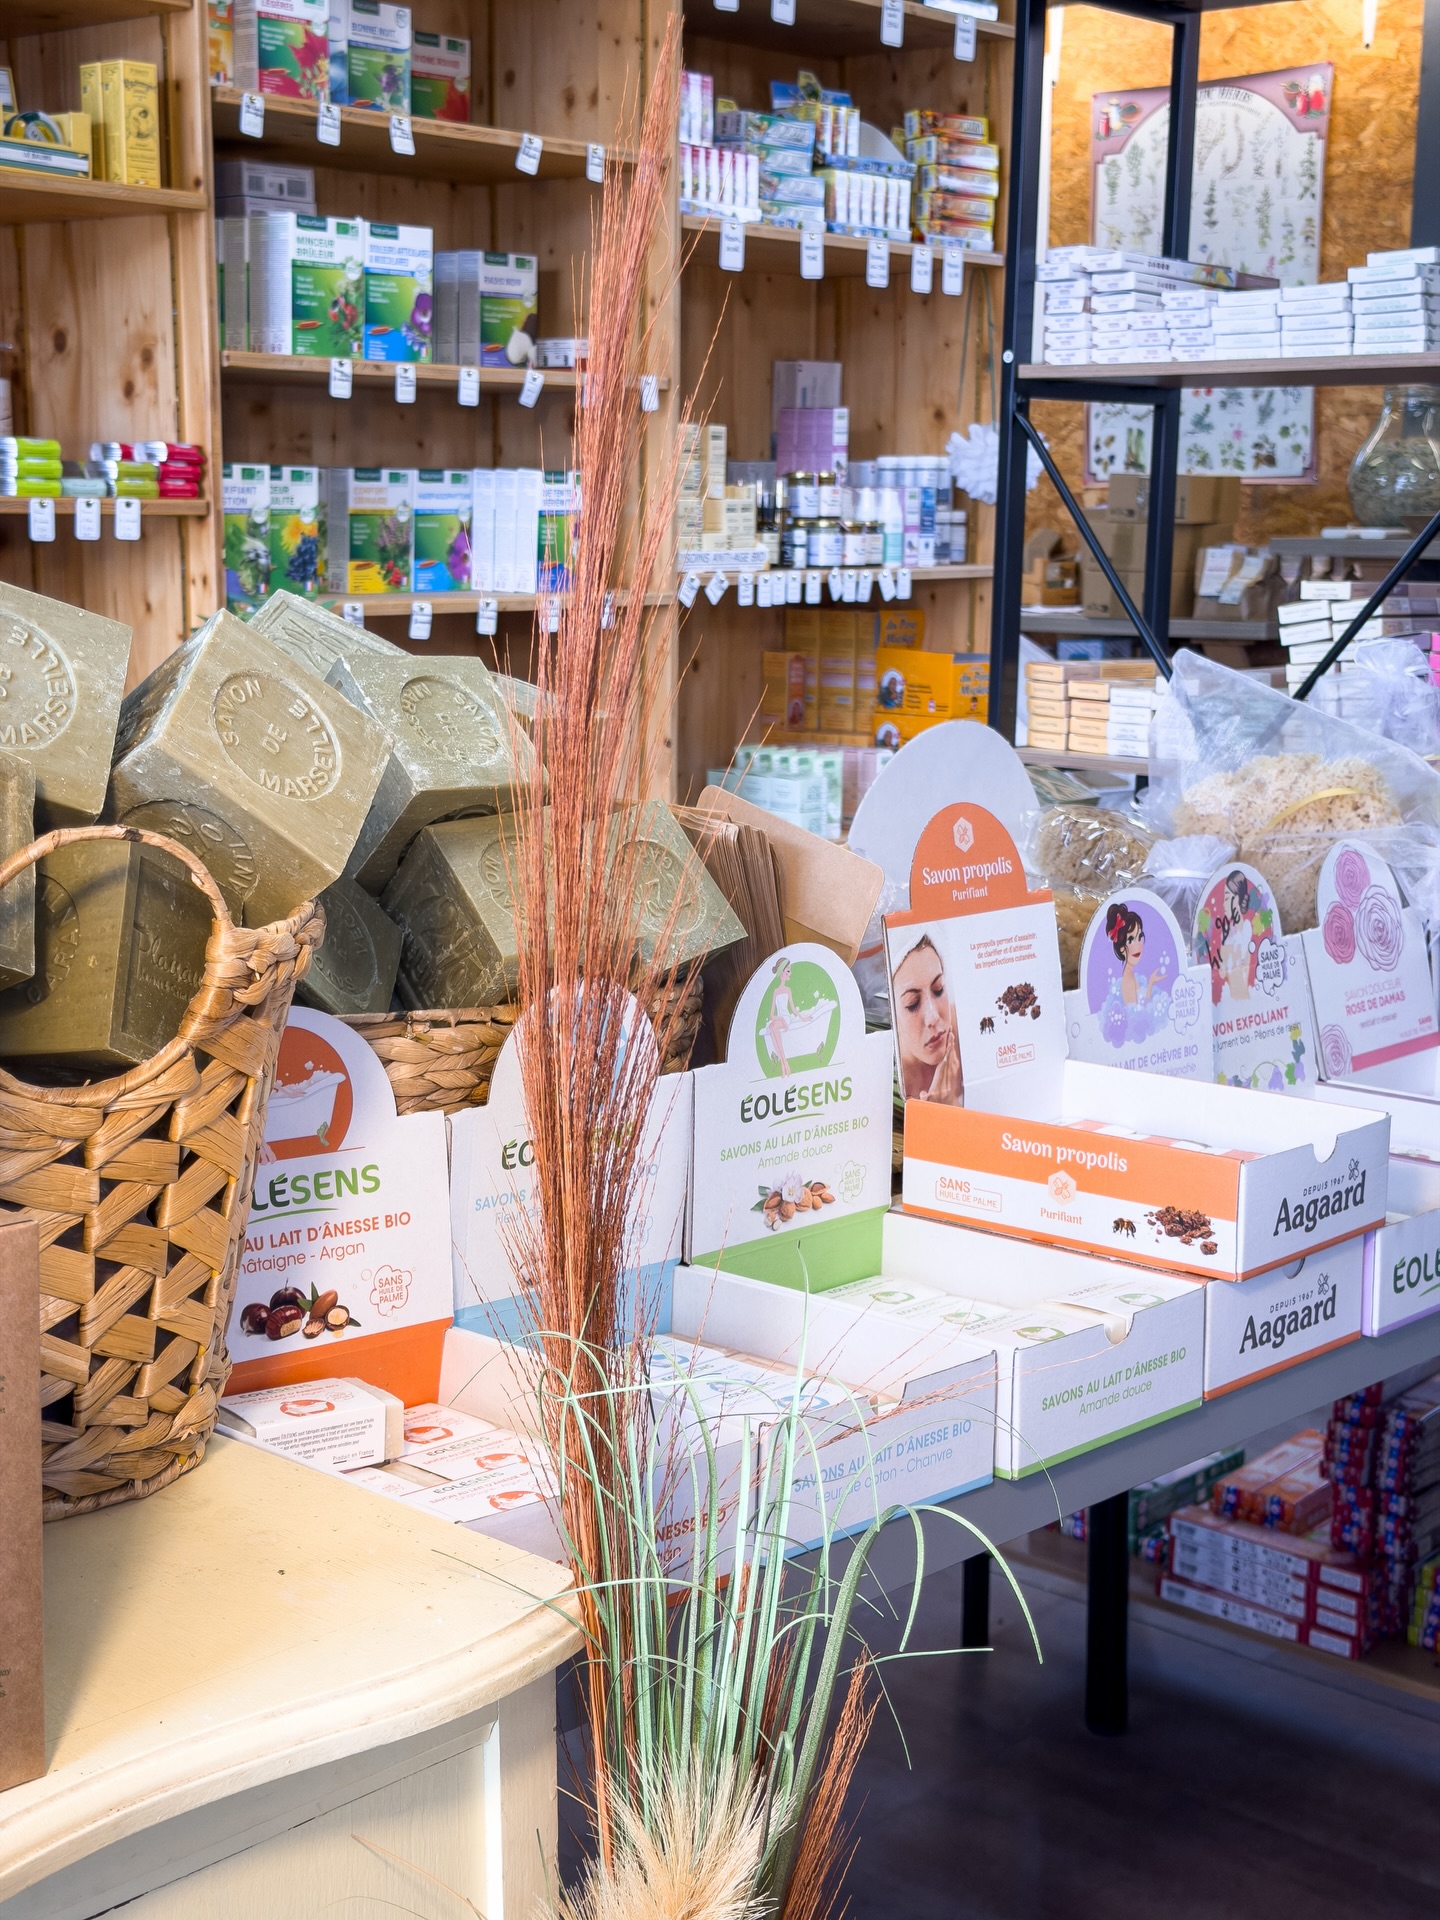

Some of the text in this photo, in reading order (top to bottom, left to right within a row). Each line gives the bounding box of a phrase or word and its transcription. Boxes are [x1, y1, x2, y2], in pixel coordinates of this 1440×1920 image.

[221, 679, 265, 747] SAVON
[259, 698, 334, 798] MARSEILLE
[261, 722, 288, 755] DE
[922, 856, 1013, 886] Savon propolis
[952, 886, 988, 901] Purifiant
[976, 939, 996, 951] propolis
[1260, 949, 1279, 963] SANS
[1262, 970, 1281, 981] PALME
[1175, 986, 1196, 1000] SANS
[1345, 990, 1406, 1017] ROSE DE DAMAS
[1175, 1009, 1196, 1018] PALME
[1213, 1006, 1289, 1037] VON EXFOLIANT
[998, 1043, 1017, 1057] SANS
[1138, 1056, 1148, 1069] DE
[1150, 1048, 1182, 1065] CHÈVRE
[1184, 1044, 1198, 1057] BIO
[1217, 1036, 1239, 1053] jument
[741, 1077, 852, 1123] ÉOLÉSENS
[720, 1116, 869, 1162] SAVONS AU LAIT D'ÂNESSE BIO
[758, 1143, 833, 1169] Amande douce
[1001, 1132, 1128, 1173] Savon propolis
[251, 1164, 381, 1211] LÉSENS
[939, 1176, 971, 1193] SANS
[1303, 1175, 1345, 1197] DEPUIS 1967
[939, 1190, 998, 1209] HUILE DE PALME
[1273, 1169, 1366, 1237] Aagaard
[1040, 1207, 1083, 1225] Purifiant
[244, 1211, 411, 1253] AU LAIT D'ÂNESSE BIO
[242, 1253, 306, 1275] âtaigne
[319, 1242, 365, 1261] Argan
[378, 1275, 403, 1288] SANS
[379, 1284, 403, 1294] HUILE DE
[379, 1292, 404, 1304] PALME
[1269, 1290, 1314, 1313] DEPUIS 1967
[1239, 1284, 1337, 1354] Aagaard
[1041, 1347, 1187, 1411] SAVONS AU LAIT D'ÂNESSE BIO
[1079, 1379, 1152, 1416] Amande douce
[333, 1454, 350, 1462] Produit
[848, 1455, 866, 1474] AU
[896, 1428, 949, 1458] D'ÂNESSE
[952, 1419, 972, 1439] BIO
[906, 1447, 953, 1473] Chanvre
